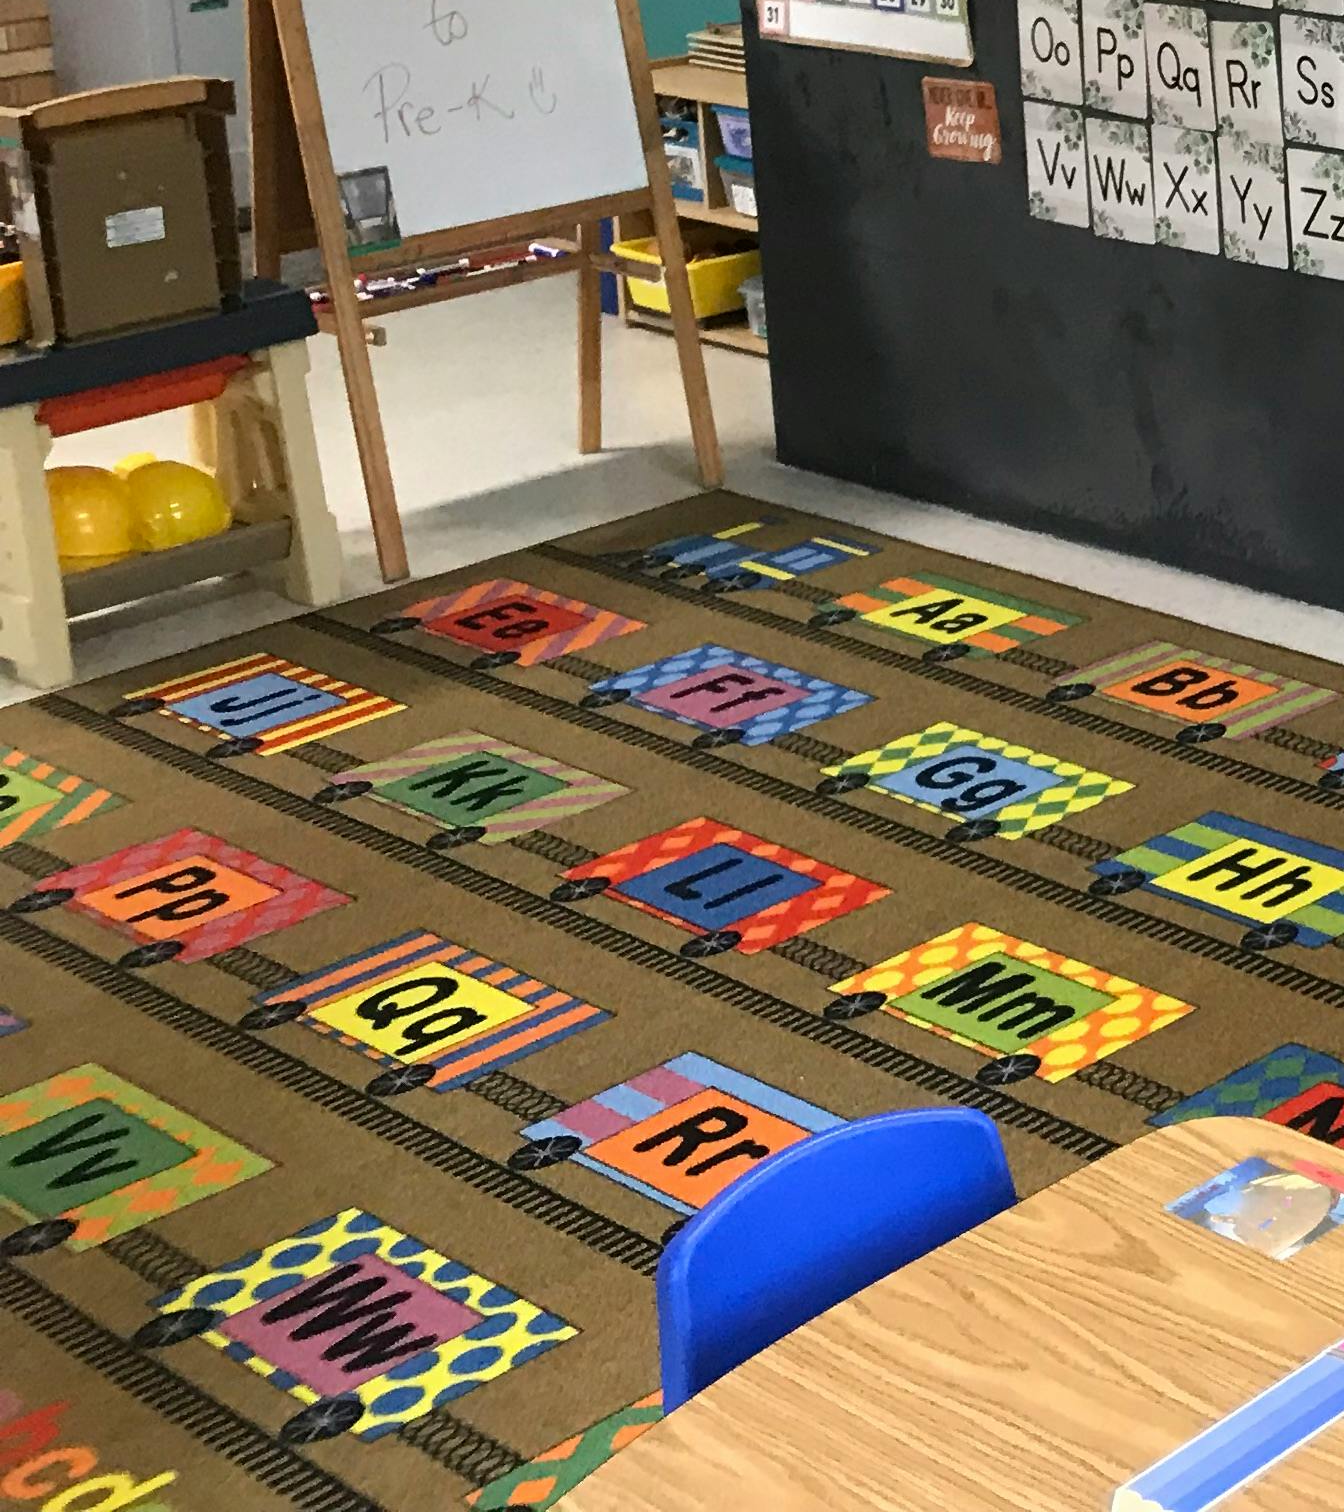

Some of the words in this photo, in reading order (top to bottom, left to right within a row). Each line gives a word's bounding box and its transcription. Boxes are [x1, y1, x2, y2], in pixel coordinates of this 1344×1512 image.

[766, 6, 779, 24] 31
[1031, 17, 1070, 66] Oo
[1097, 27, 1134, 91] Pp
[1157, 42, 1201, 108] Qq
[1226, 59, 1260, 109] Rr
[1297, 56, 1335, 109] Ss
[363, 62, 514, 143] Pre-K
[945, 105, 975, 131] Keep
[933, 123, 997, 162] Growing
[1037, 138, 1076, 189] Vv
[1094, 154, 1146, 206] Ww
[1163, 161, 1208, 216] Xx
[1230, 174, 1273, 241] Yy
[453, 603, 545, 640] Ee
[898, 597, 989, 635] Aa
[209, 684, 326, 730] Jj
[668, 674, 786, 713] Ff
[1130, 665, 1245, 712] Bb
[408, 760, 526, 811] Kk
[913, 756, 1026, 815] Gg
[115, 867, 217, 924] Pp
[662, 859, 784, 911] Ll
[1187, 848, 1314, 909] Hh
[355, 975, 488, 1056] Qq
[920, 960, 1076, 1040] Mm
[10, 1112, 138, 1191] Vv
[633, 1105, 768, 1178] Rr
[260, 1262, 439, 1373] Ww
